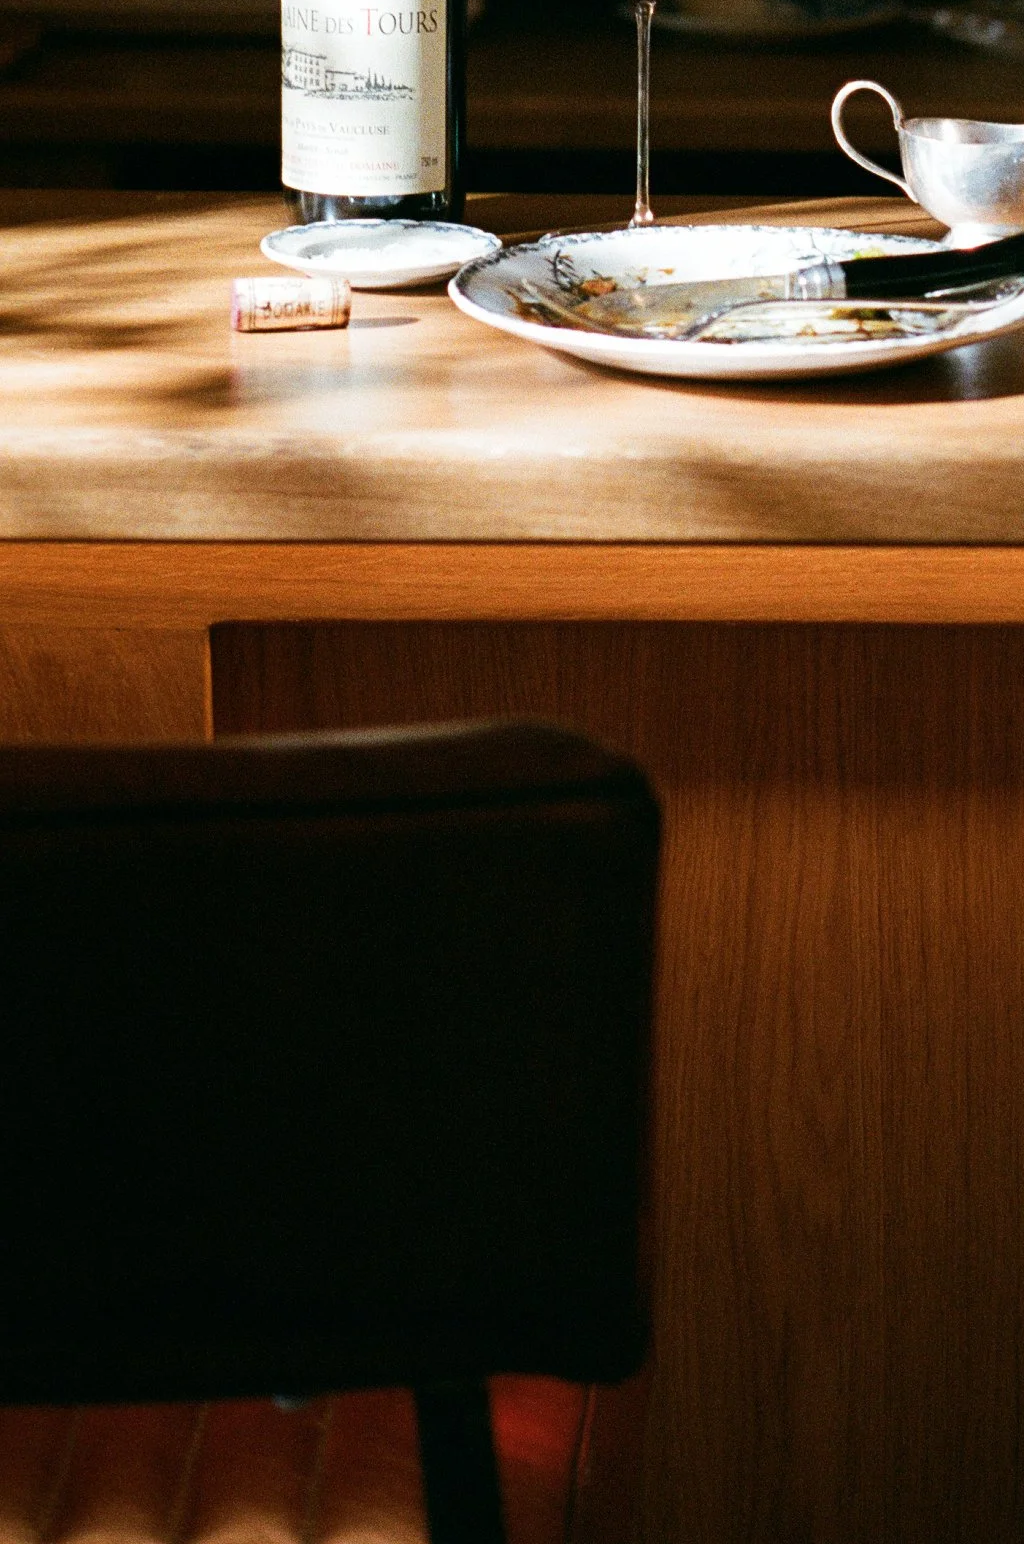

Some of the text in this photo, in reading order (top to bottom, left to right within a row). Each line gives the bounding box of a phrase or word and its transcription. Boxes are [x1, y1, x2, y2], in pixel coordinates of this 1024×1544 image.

[325, 16, 354, 34] DES
[359, 7, 438, 36] TOURS
[328, 121, 390, 136] VAUCLUSE
